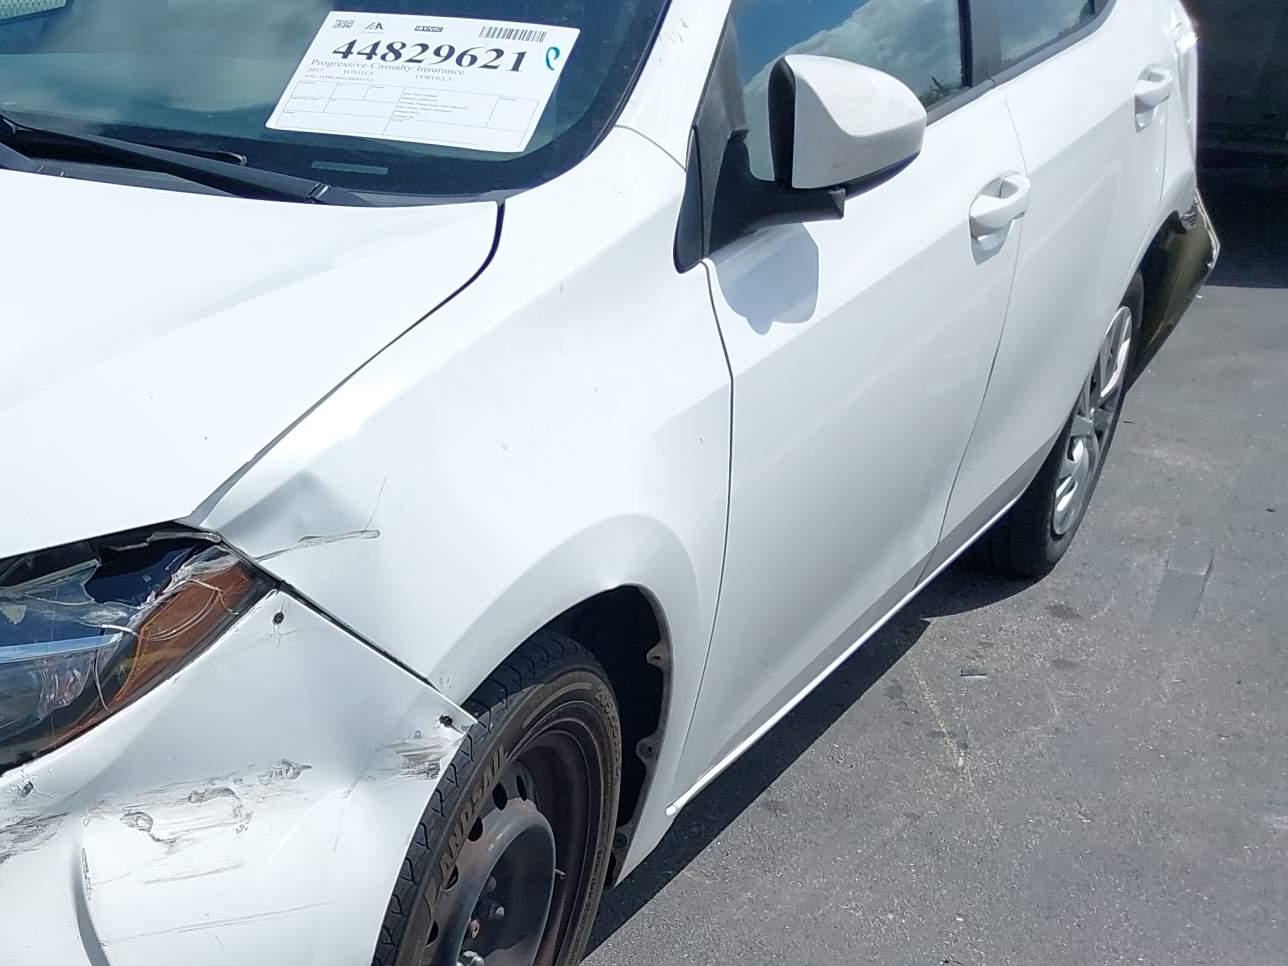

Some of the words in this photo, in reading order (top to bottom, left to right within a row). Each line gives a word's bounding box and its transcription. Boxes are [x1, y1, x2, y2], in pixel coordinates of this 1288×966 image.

[311, 58, 368, 69] Progressive
[370, 62, 415, 73] Casualty
[415, 65, 465, 76] Insurance
[332, 38, 527, 73] 44829621
